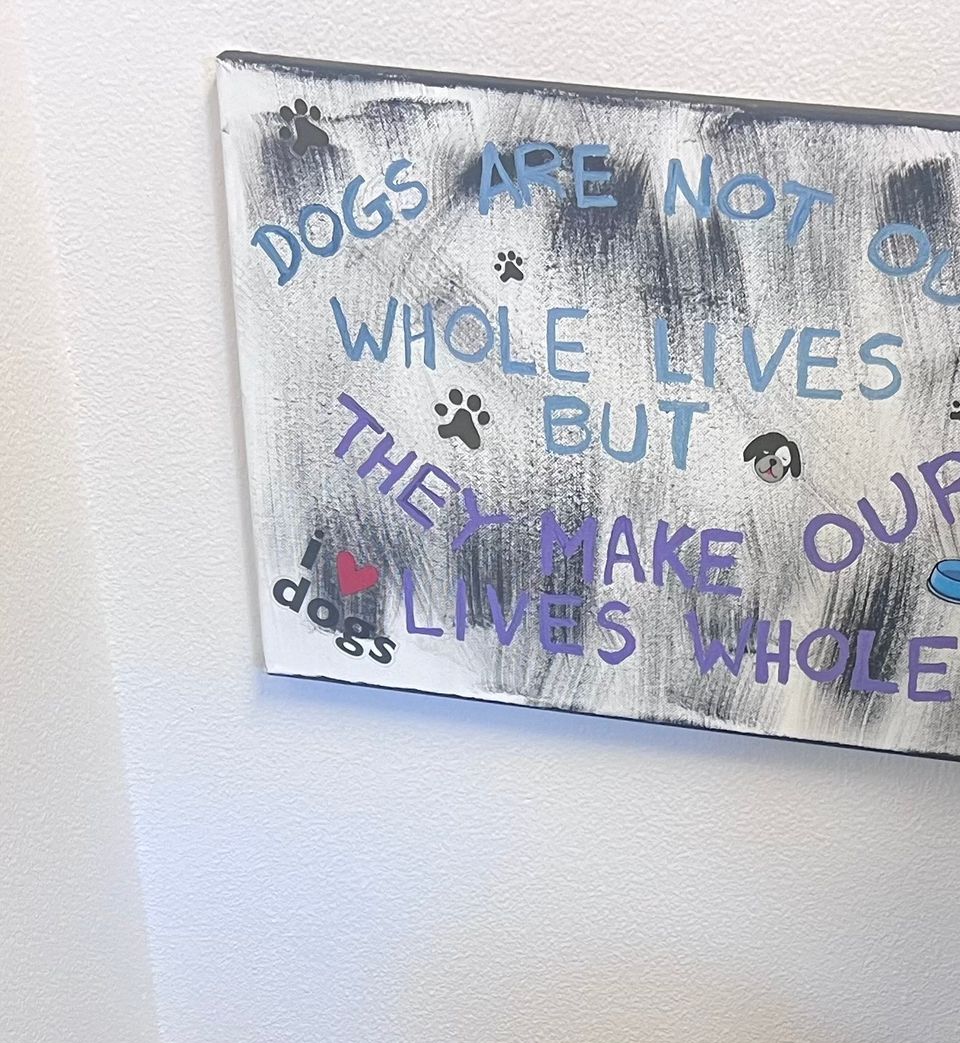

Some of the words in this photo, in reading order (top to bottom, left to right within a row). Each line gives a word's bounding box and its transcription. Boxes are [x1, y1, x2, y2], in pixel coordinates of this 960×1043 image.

[251, 159, 428, 286] DOGS
[479, 142, 617, 215] ARE
[664, 155, 834, 246] NOT
[330, 297, 590, 383] WHOLE
[654, 318, 903, 401] LIVES
[543, 395, 709, 470] BUT
[334, 392, 510, 551] THEY
[540, 509, 744, 597] MAKE
[300, 529, 324, 570] i
[272, 576, 397, 665] dogs
[403, 568, 636, 665] LIVES
[684, 610, 958, 702] WHOLE
